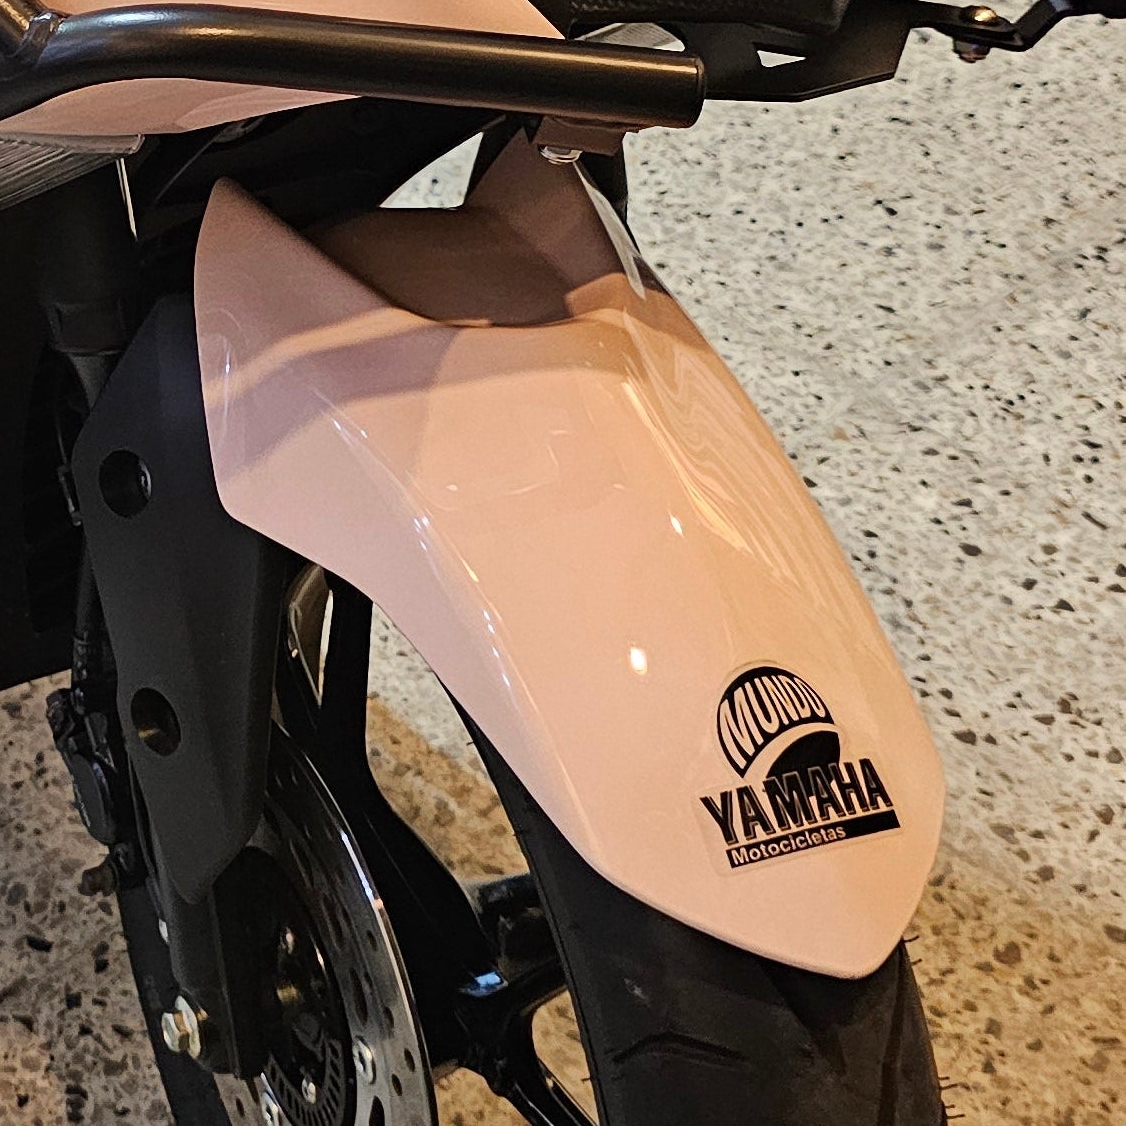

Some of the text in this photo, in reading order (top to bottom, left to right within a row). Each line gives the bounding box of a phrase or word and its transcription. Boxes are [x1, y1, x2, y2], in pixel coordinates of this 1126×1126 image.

[719, 674, 826, 770] MUNDO
[699, 758, 894, 844] YAMAHA
[731, 824, 847, 866] Motocicletas
